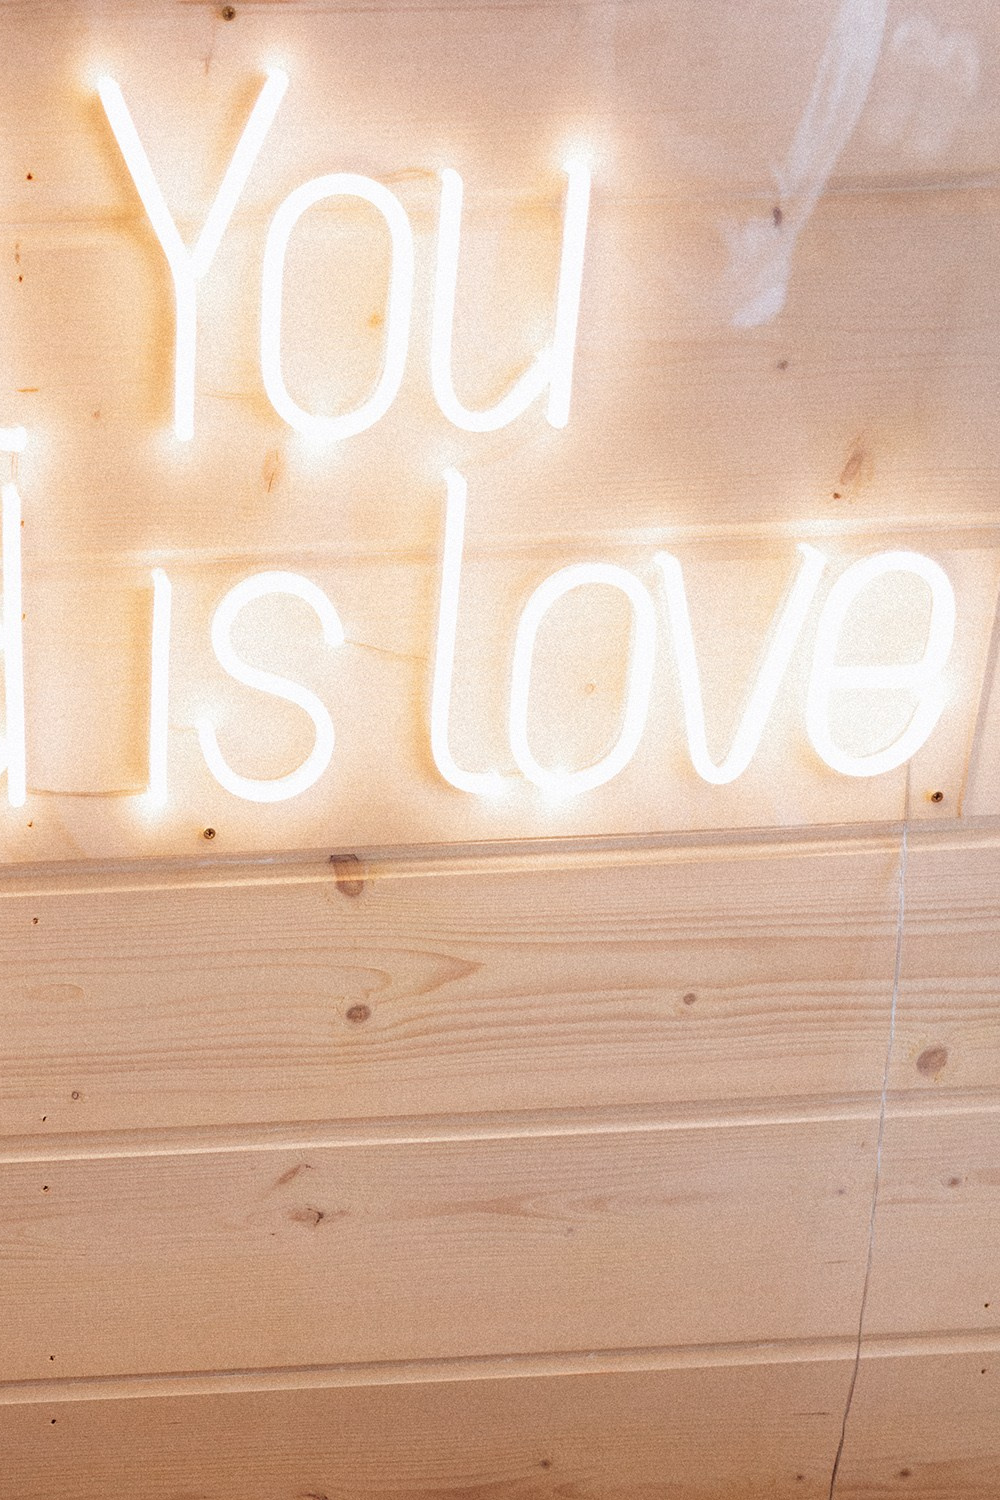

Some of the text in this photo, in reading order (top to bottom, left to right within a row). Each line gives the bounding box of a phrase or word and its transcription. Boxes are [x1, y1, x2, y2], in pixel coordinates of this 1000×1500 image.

[95, 68, 593, 443] You
[138, 566, 347, 805] is
[428, 467, 958, 800] love
